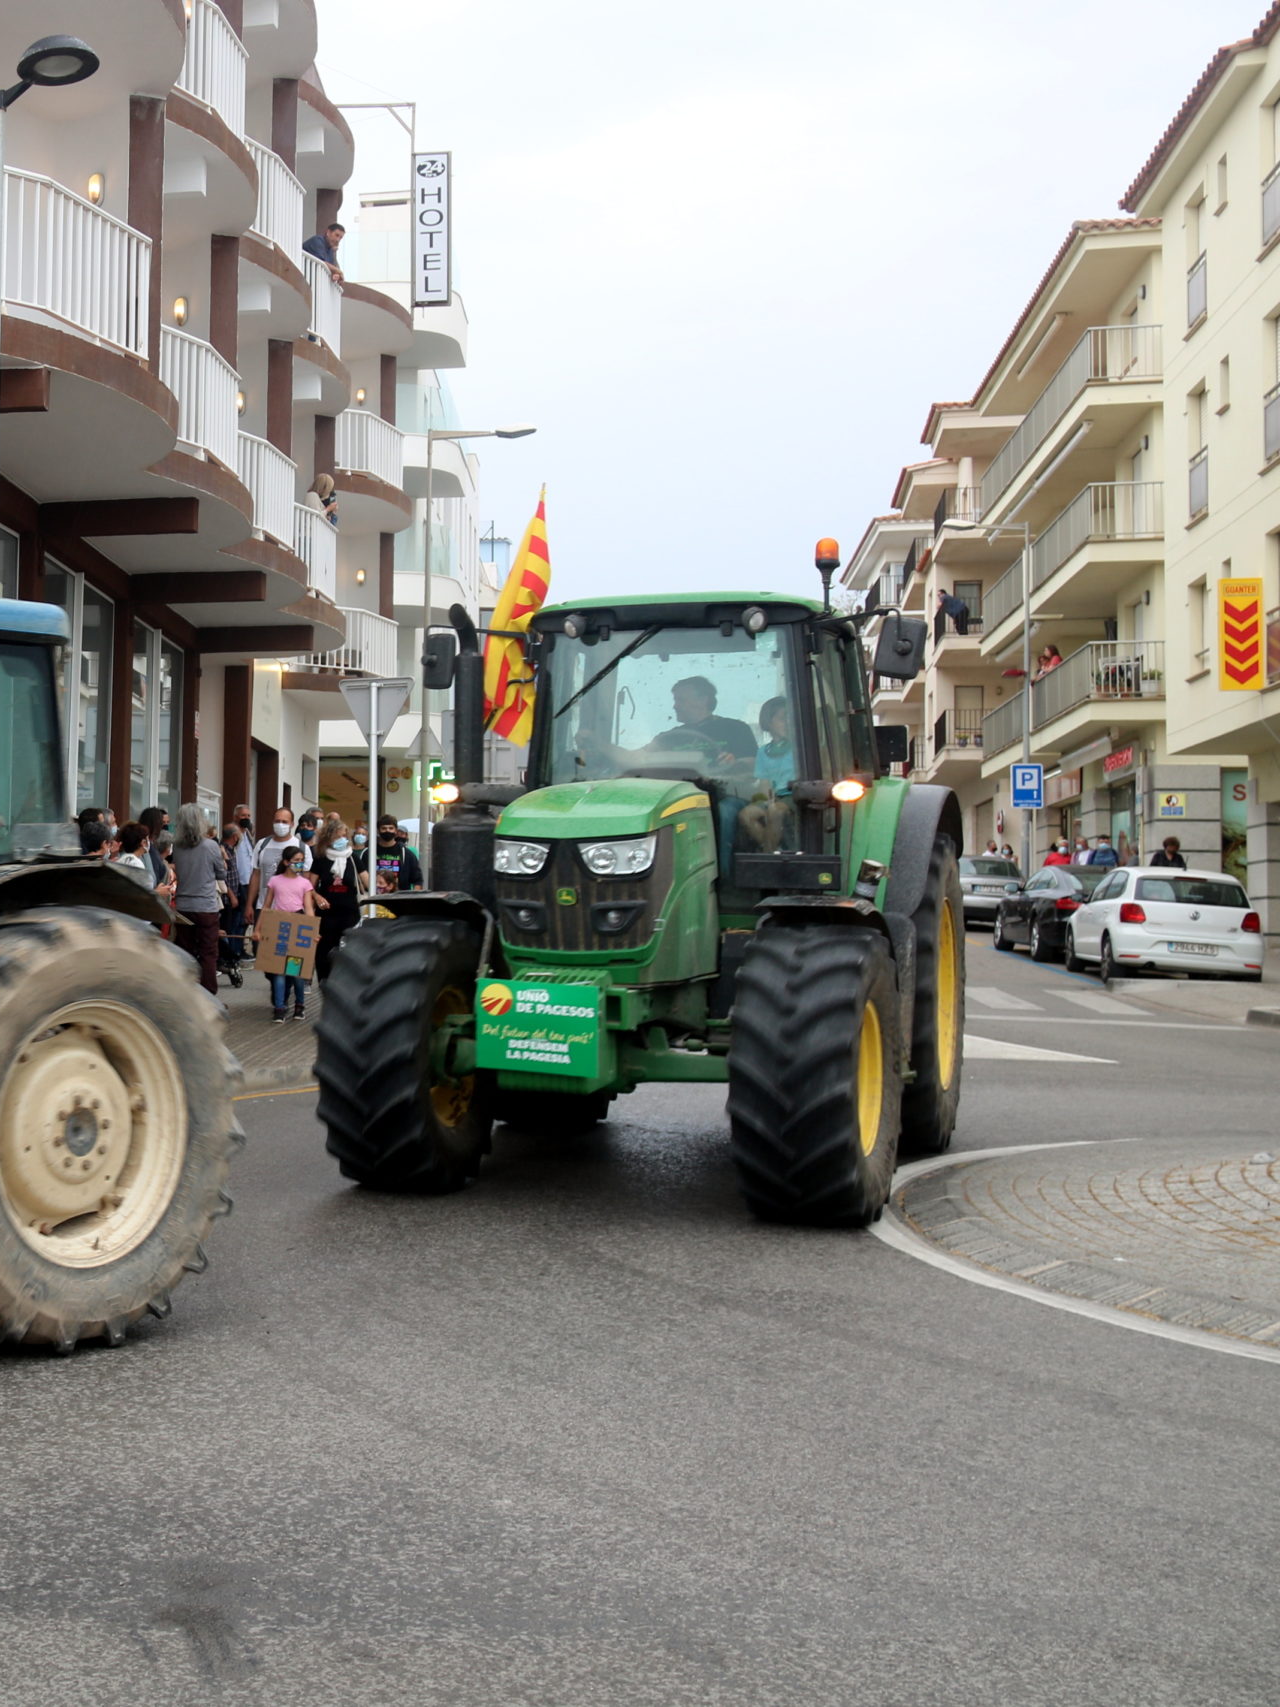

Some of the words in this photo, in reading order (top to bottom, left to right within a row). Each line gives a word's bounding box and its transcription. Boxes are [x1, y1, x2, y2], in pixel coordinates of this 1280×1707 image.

[420, 160, 444, 174] 24
[419, 187, 444, 293] HOTEL
[1022, 772, 1034, 786] P
[1232, 784, 1247, 801] S
[516, 988, 550, 1002] UNIÓ
[516, 1002, 533, 1013] DE
[535, 1004, 596, 1018] PAGESOS
[508, 1039, 569, 1052] DEFENSEM
[506, 1050, 522, 1060] LA
